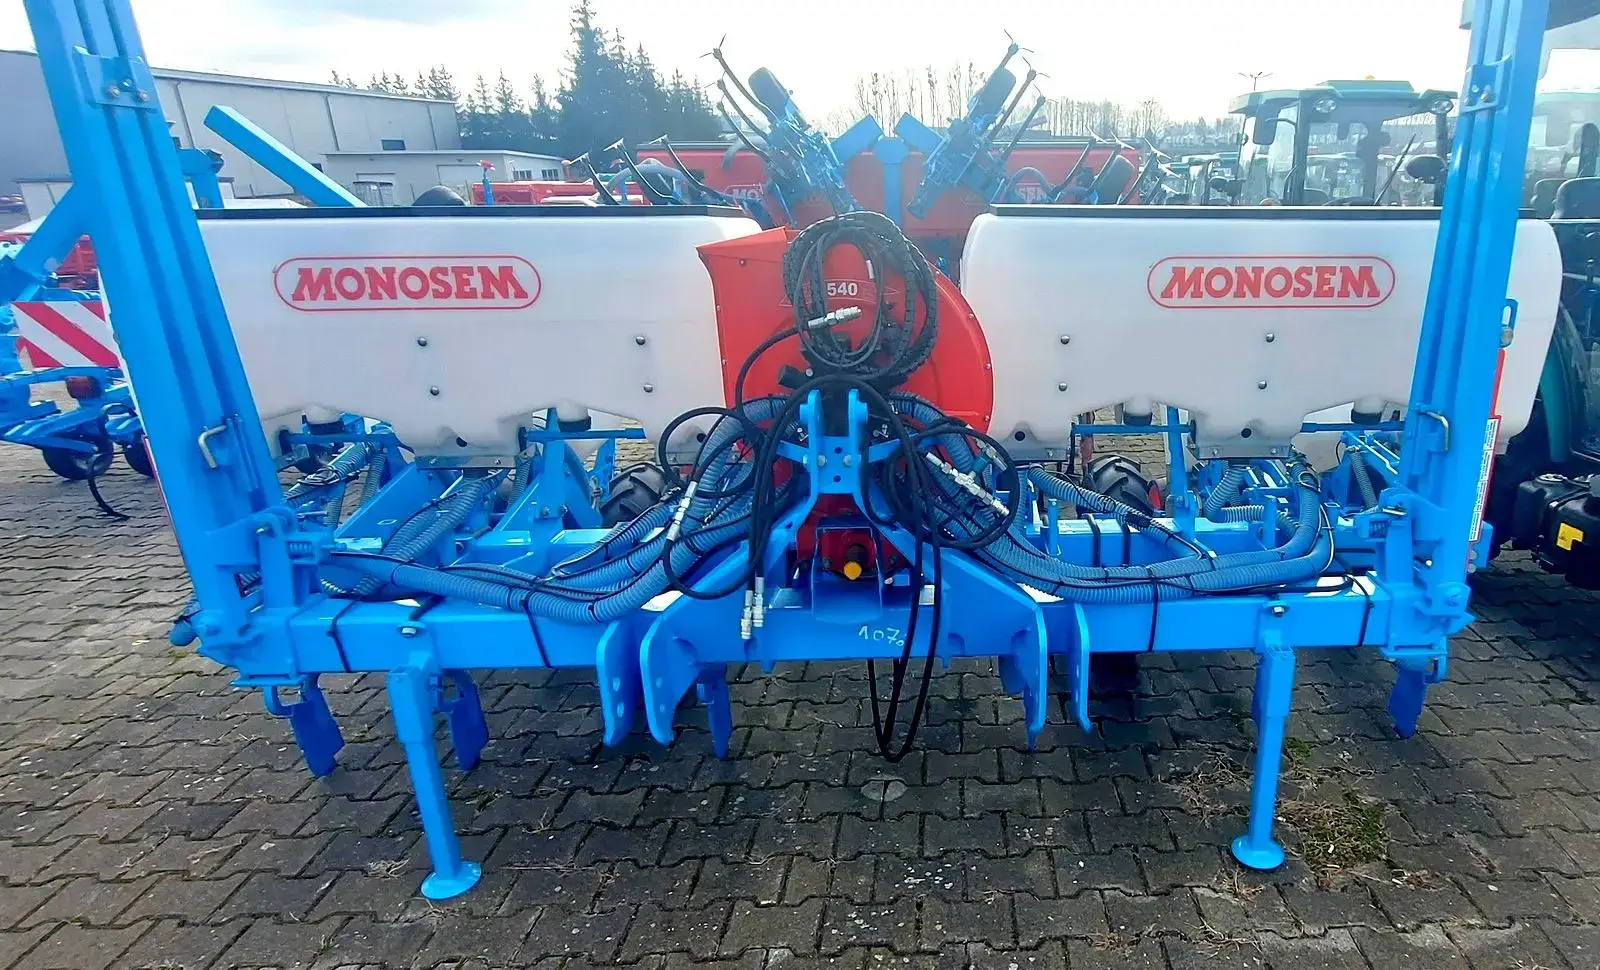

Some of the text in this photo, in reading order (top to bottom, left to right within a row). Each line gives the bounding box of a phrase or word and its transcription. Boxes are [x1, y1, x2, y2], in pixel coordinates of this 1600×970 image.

[291, 265, 529, 301] MONOSEM
[826, 282, 858, 296] 540
[1160, 266, 1380, 298] MONOSEM
